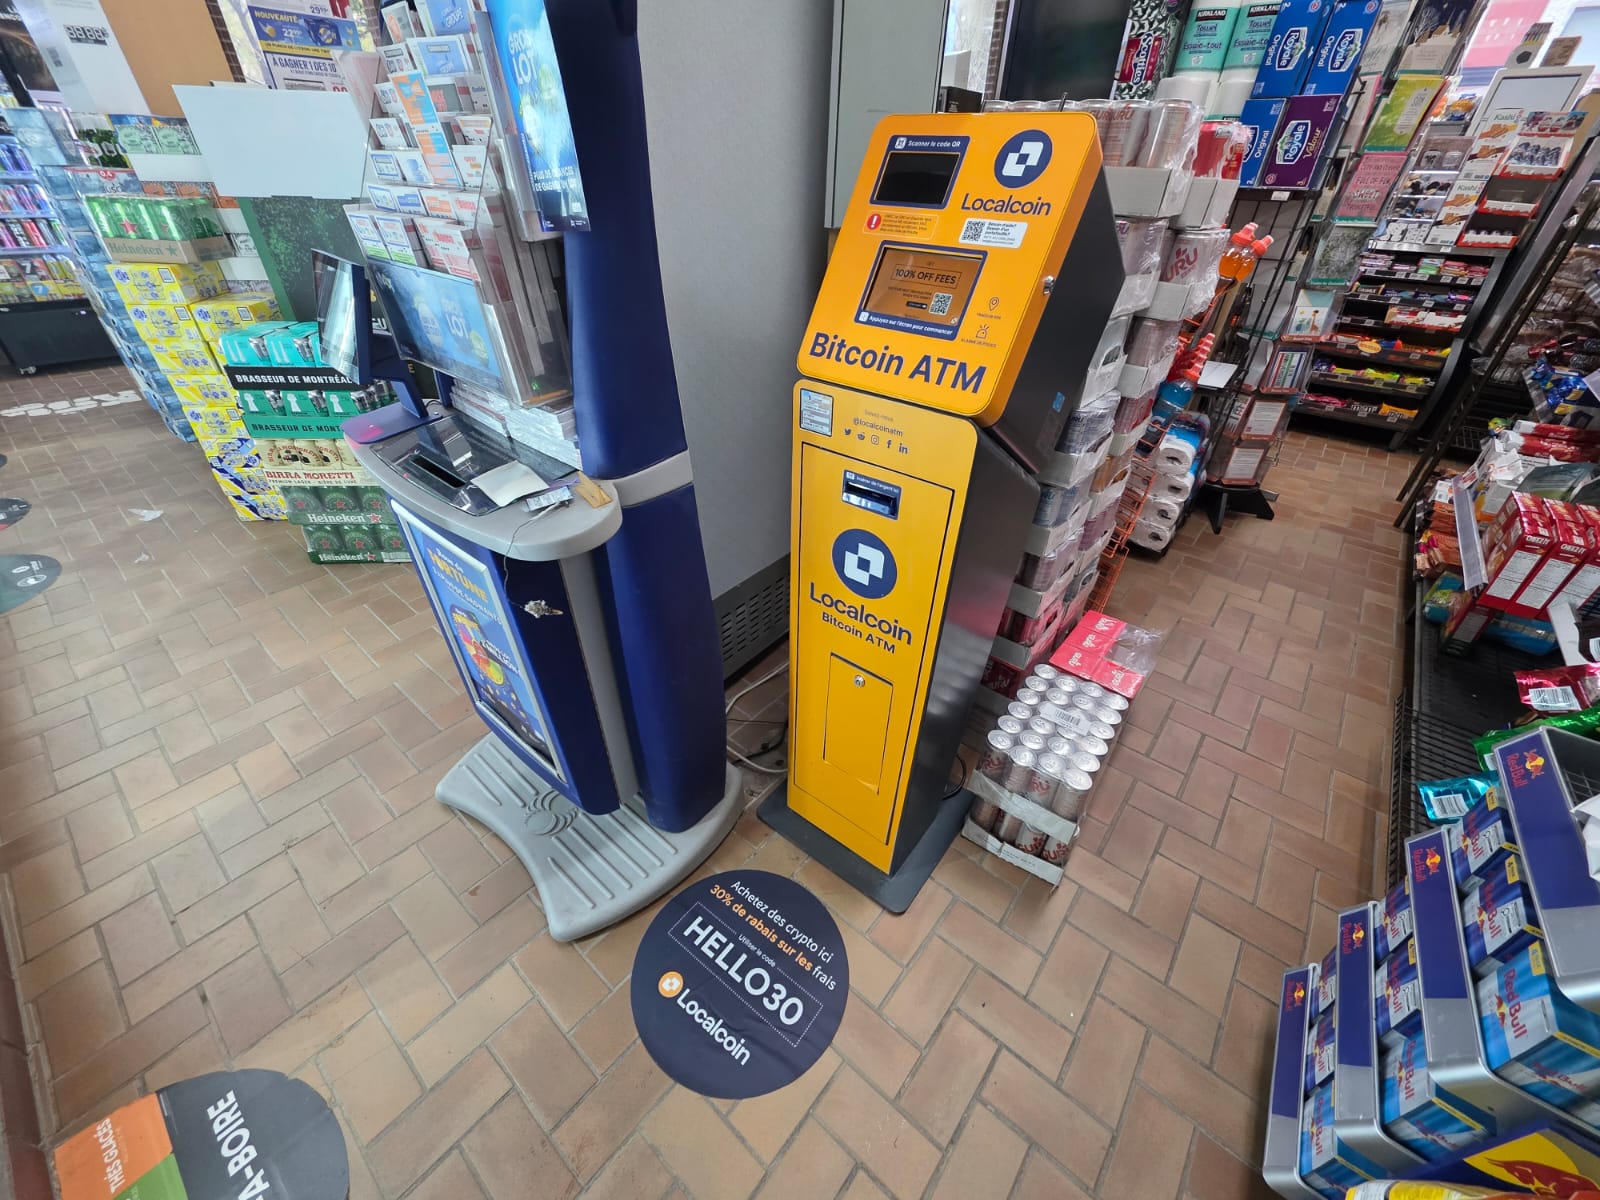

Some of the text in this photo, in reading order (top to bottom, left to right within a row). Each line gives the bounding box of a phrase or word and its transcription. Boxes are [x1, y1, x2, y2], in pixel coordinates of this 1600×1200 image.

[1197, 10, 1227, 18] KIRKLAND
[278, 57, 309, 70] GAGNER
[314, 60, 328, 72] DES
[1132, 33, 1154, 85] Scotties
[1265, 34, 1282, 66] Original
[1280, 31, 1300, 66] Royale
[1317, 36, 1335, 67] Original
[1332, 33, 1354, 68] Royale
[512, 53, 538, 85] LOT
[1254, 130, 1270, 158] Original
[1284, 124, 1306, 160] Royale
[1302, 127, 1321, 159] Velour
[961, 192, 1052, 216] Localcoin
[108, 243, 164, 257] Heineken
[895, 268, 957, 285] 100% OFF FEES
[868, 315, 889, 324] Appuyez
[924, 326, 954, 336] commencer
[235, 372, 353, 385] BRASSEUR DE MONTRÉAL
[809, 331, 987, 394] Bitcoin ATM
[252, 423, 343, 433] BRASSEUR DE MONT
[852, 417, 904, 437] @localcoinatm
[265, 470, 355, 480] BIRRA MORETTI
[307, 513, 366, 524] Heineken
[319, 552, 364, 562] Heineken
[809, 581, 913, 645] Localcoin
[821, 612, 895, 654] Bitcoin ATM
[1470, 834, 1485, 860] Bull
[709, 884, 838, 992] 30% de rabais sur les frais
[730, 880, 835, 965] Achetez des crypto ici
[1487, 909, 1502, 939] Bull
[738, 933, 758, 955] Utiliser
[761, 952, 778, 969] code
[682, 914, 804, 1026] HELLO30
[1392, 986, 1402, 1014] Bull
[1502, 968, 1529, 1040] Red Bull
[676, 988, 752, 1067] Localcoin
[1404, 1067, 1416, 1101] Bull
[93, 1117, 126, 1195] THÉS GLACÉS
